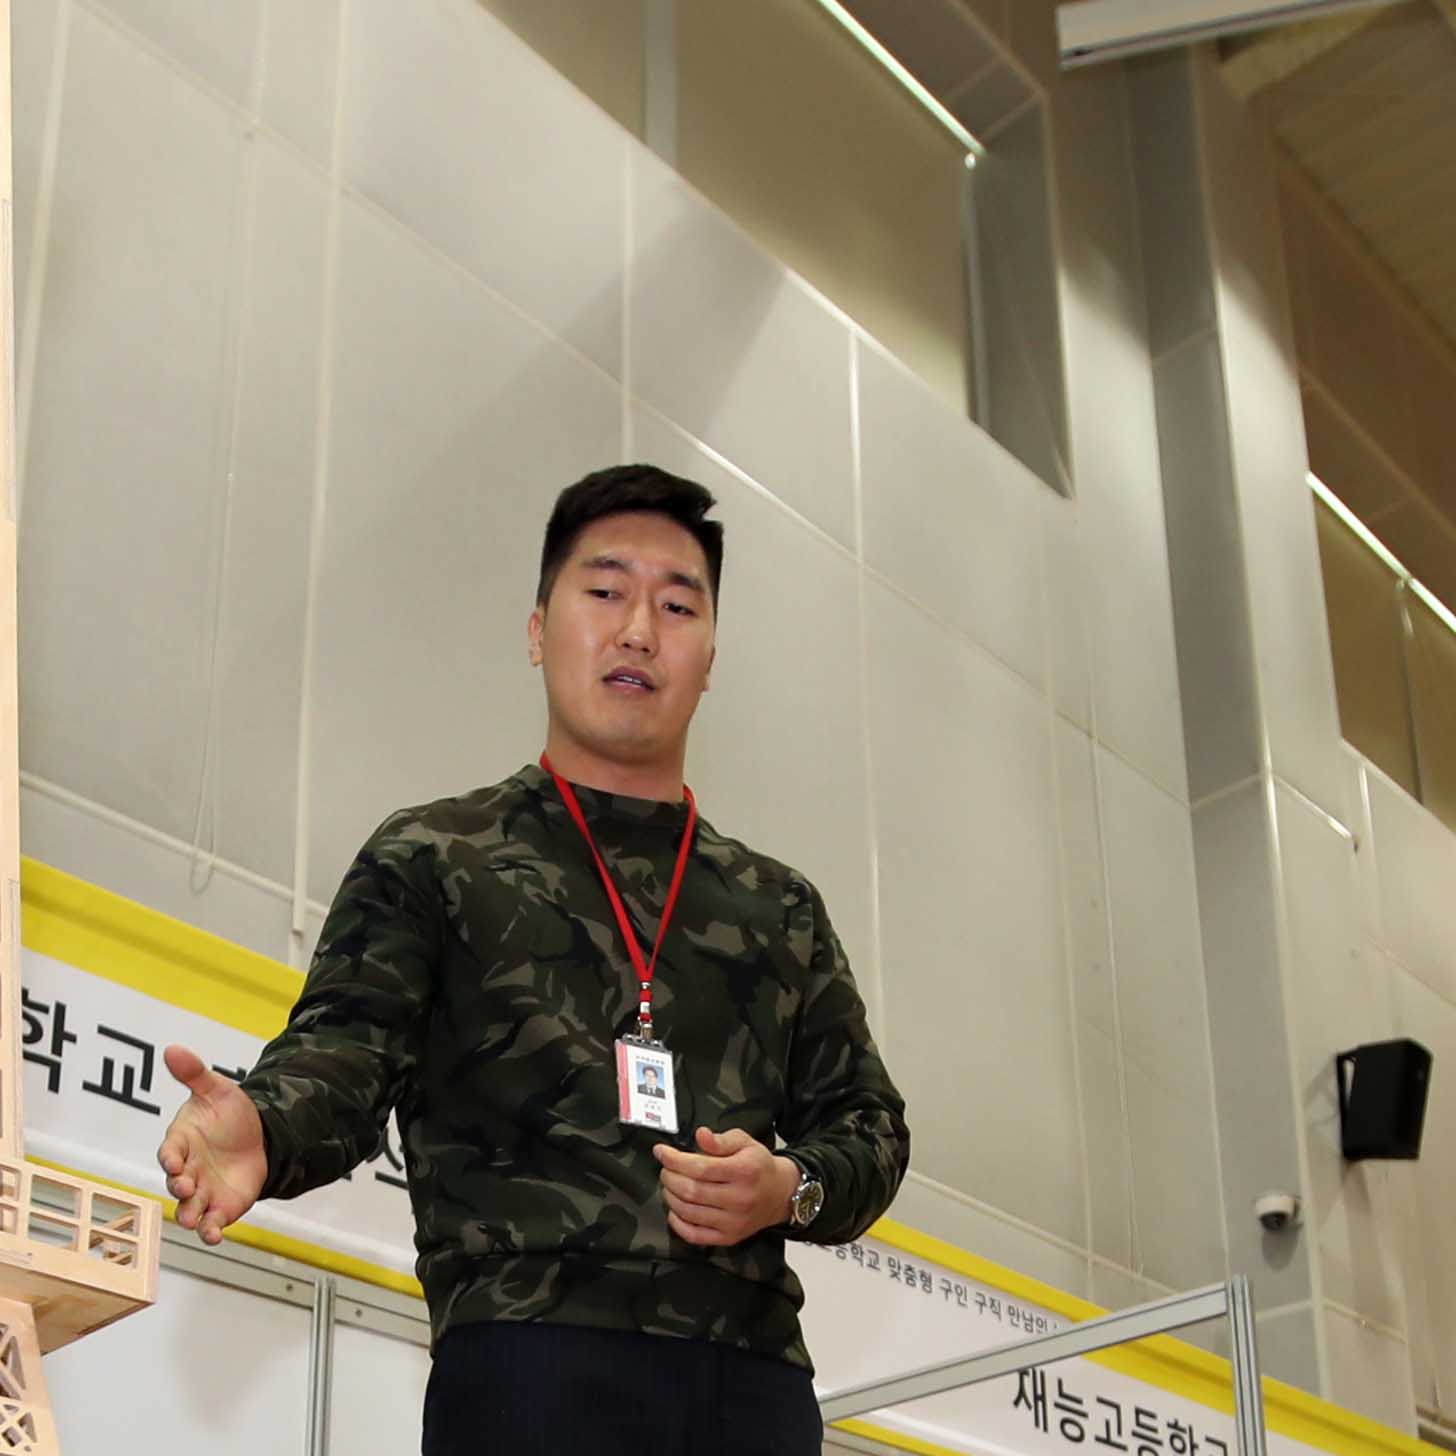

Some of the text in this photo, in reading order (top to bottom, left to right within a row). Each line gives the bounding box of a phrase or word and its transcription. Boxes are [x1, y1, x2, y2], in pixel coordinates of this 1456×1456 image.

[887, 1257, 933, 1294] 맞춤형
[940, 1278, 969, 1308] 구인
[975, 1292, 1002, 1321] 구직
